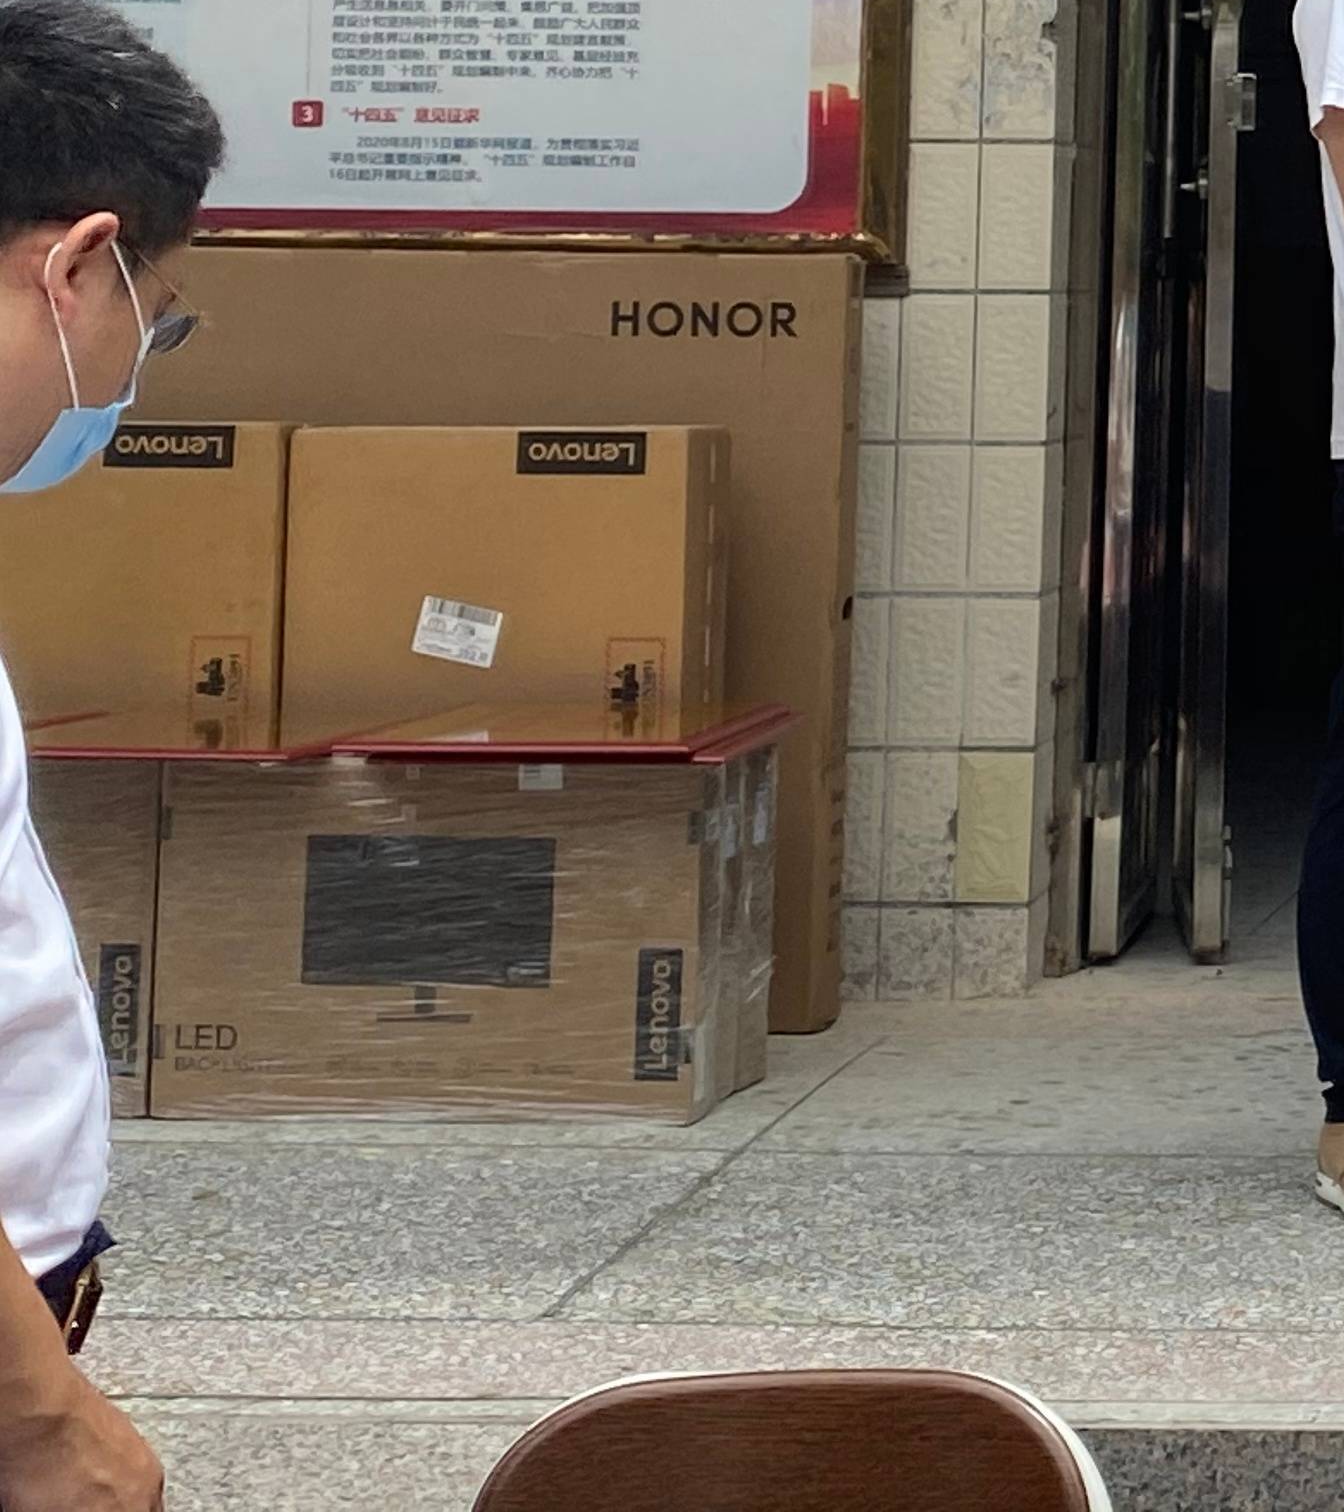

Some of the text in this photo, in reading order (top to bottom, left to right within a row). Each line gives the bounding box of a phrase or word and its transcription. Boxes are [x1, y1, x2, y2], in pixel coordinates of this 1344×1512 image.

[611, 301, 797, 337] HONOR
[115, 434, 224, 460] Lenovo
[528, 442, 636, 466] Lenovo
[108, 954, 135, 1074] Lenovo
[643, 959, 672, 1071] Lenovo
[174, 1024, 239, 1050] LED
